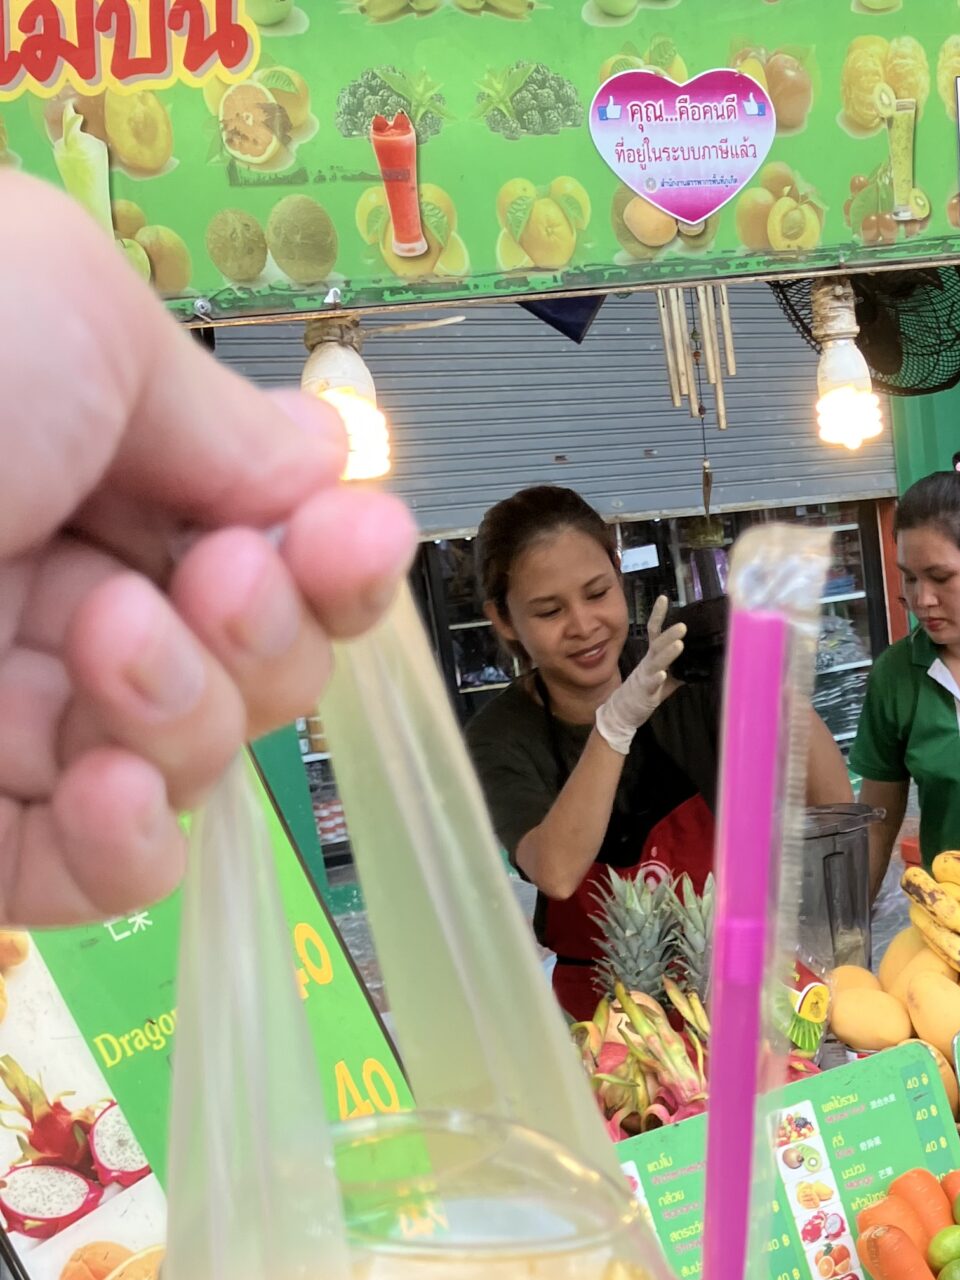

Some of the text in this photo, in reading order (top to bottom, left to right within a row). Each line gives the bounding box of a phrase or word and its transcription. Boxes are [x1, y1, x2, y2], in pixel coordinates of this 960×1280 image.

[615, 137, 758, 170] ที่อยู่ในระบบภาษีแล้ว
[335, 1057, 400, 1120] 40
[906, 1077, 919, 1089] 40
[915, 1108, 928, 1121] 40
[925, 1140, 937, 1153] 40
